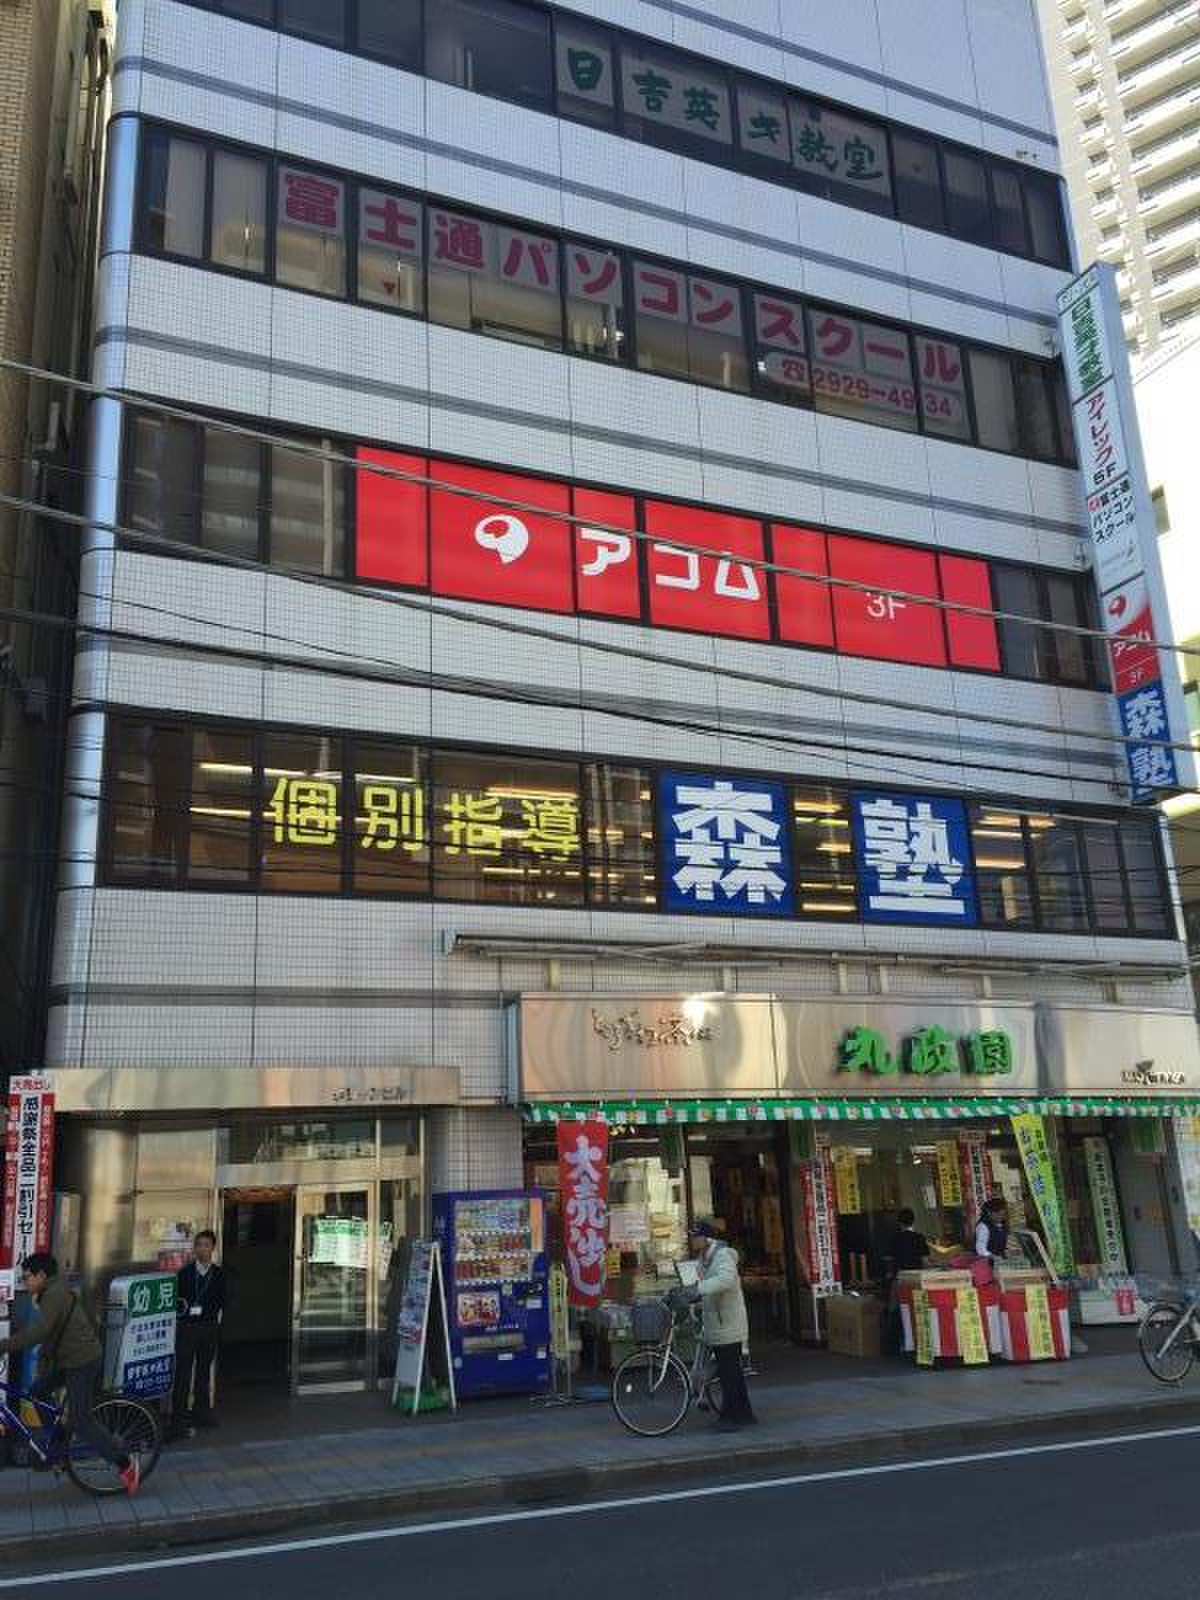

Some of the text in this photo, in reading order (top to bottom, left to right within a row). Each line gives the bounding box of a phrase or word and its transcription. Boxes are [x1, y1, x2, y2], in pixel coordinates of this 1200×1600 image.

[285, 174, 961, 382] 富士通パソコンスクール
[581, 526, 762, 601] アコム
[866, 591, 907, 619] 3F
[271, 778, 581, 862] 個別指導
